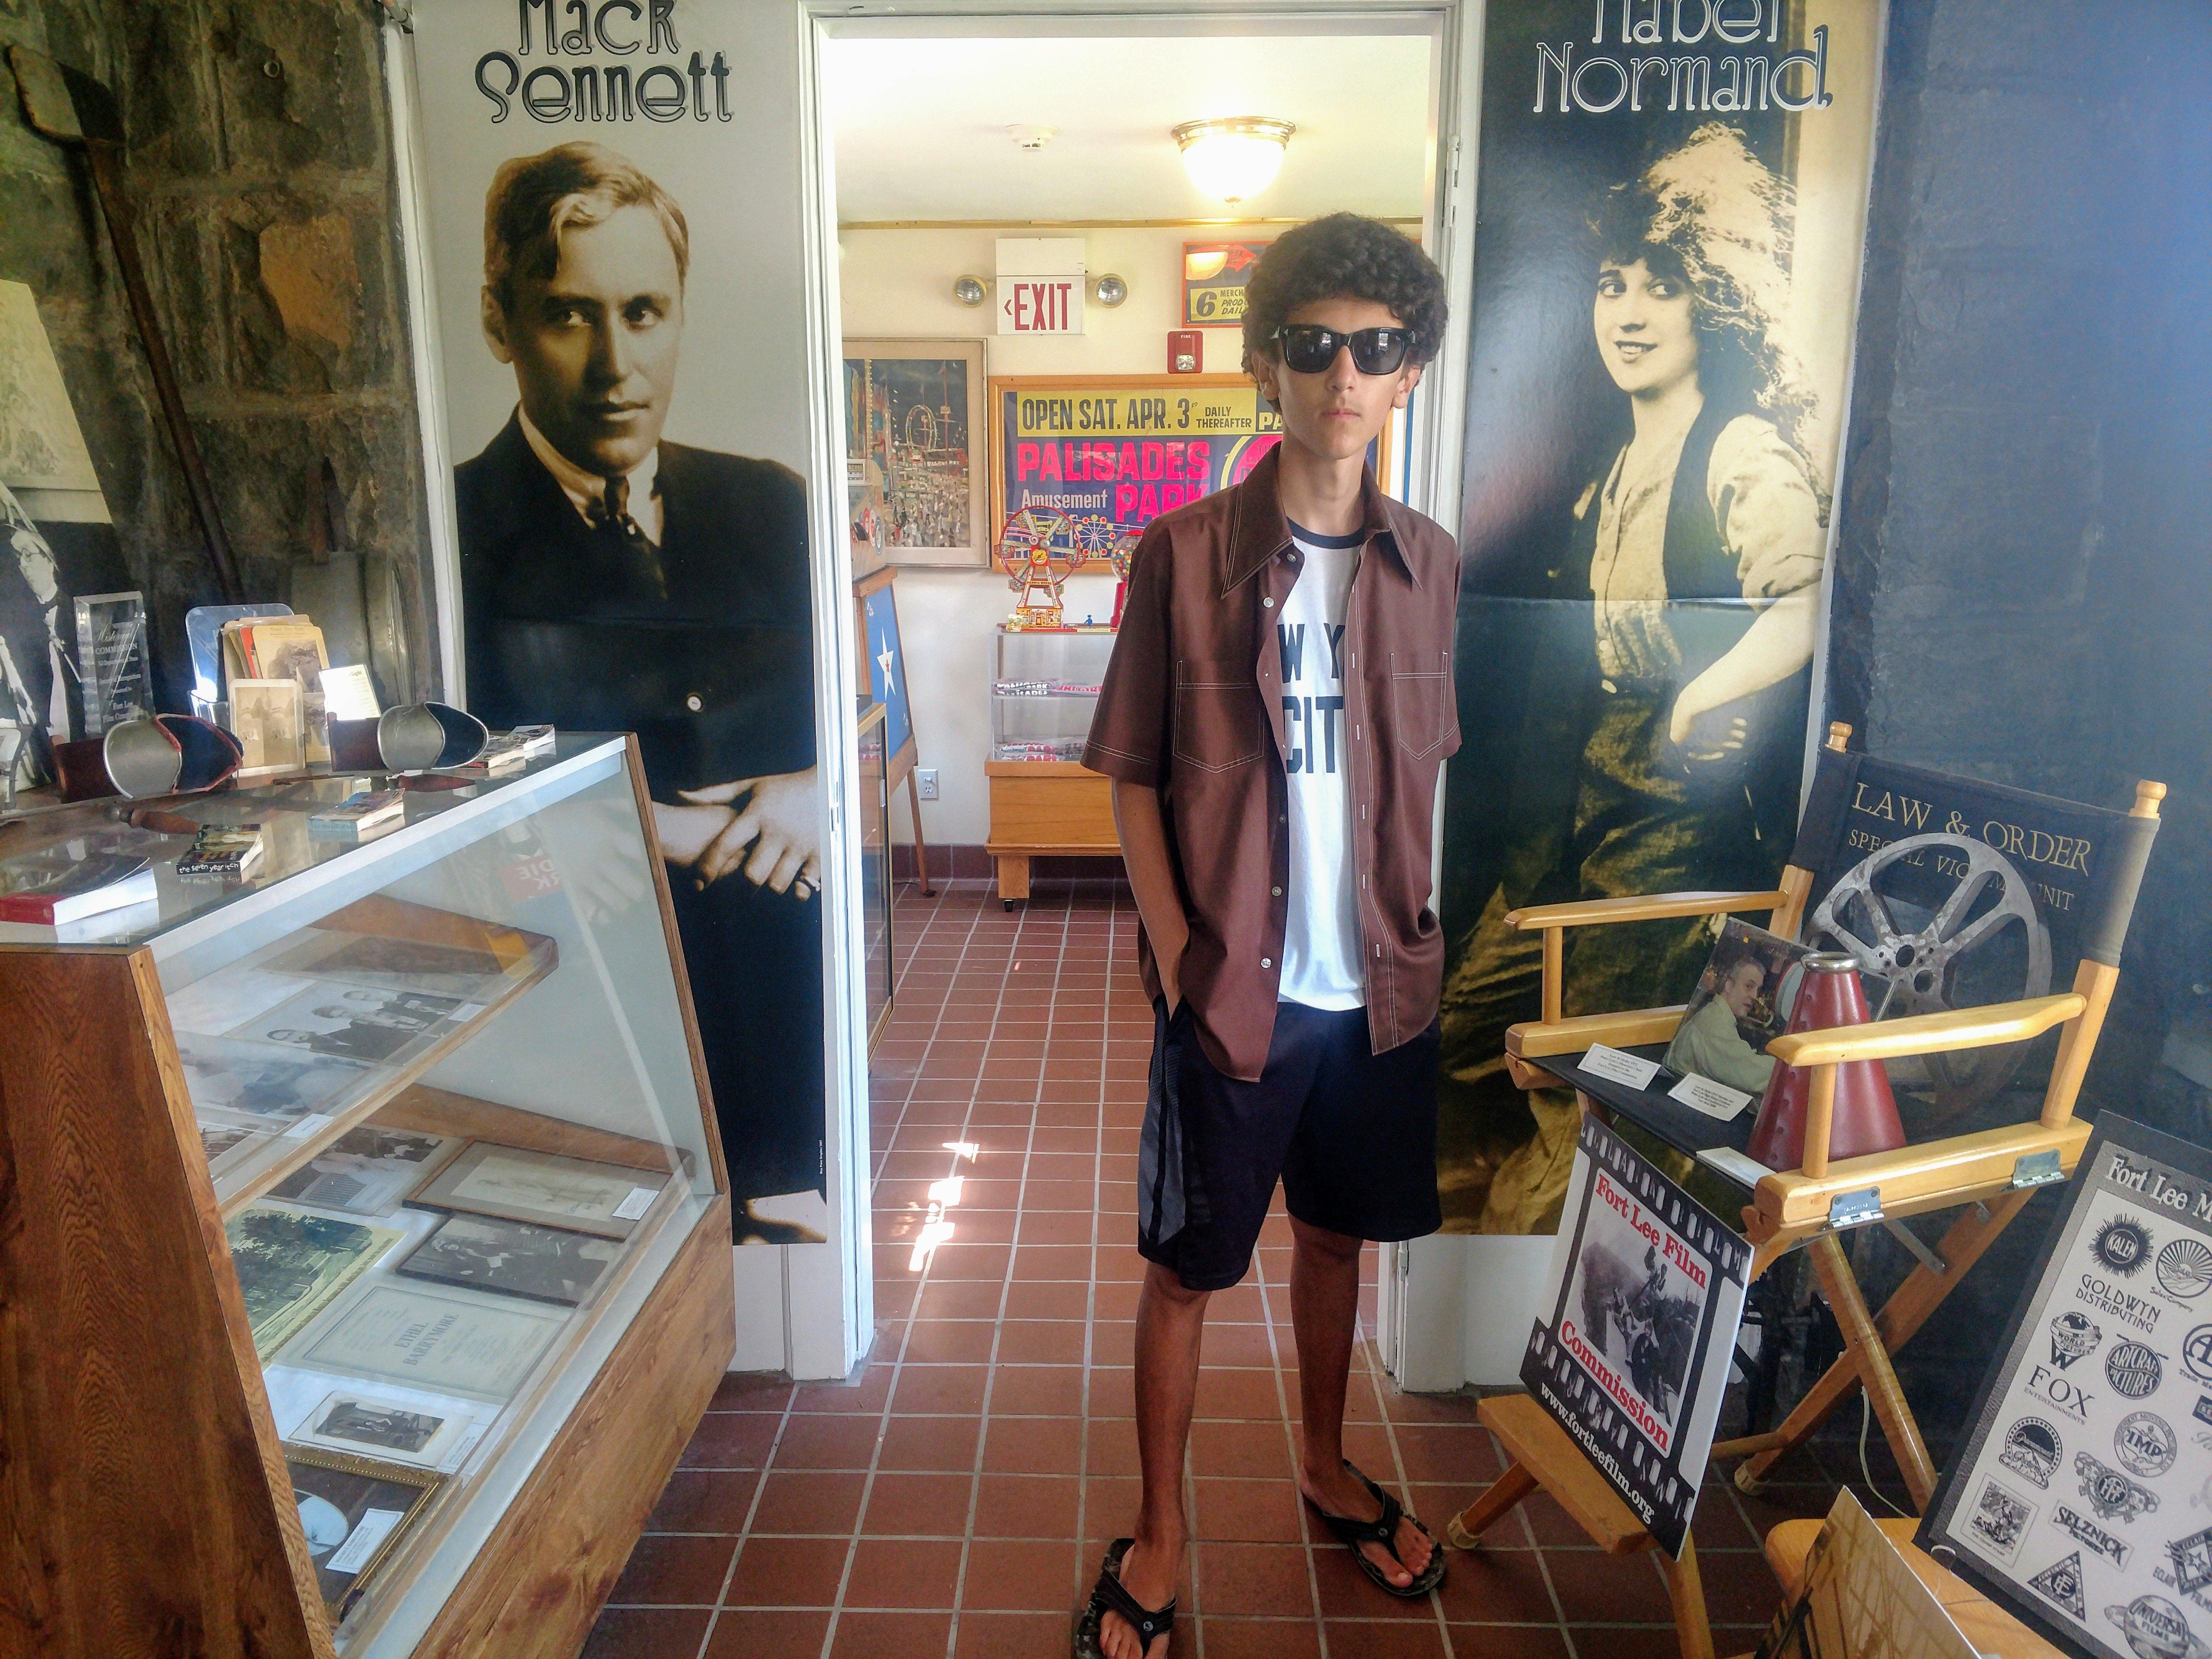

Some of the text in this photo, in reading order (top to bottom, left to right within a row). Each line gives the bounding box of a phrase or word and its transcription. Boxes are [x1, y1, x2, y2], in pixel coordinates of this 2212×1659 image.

[475, 51, 733, 124] Sennett
[1533, 31, 1830, 113] Normand
[1014, 283, 1071, 330] EXIT
[1196, 291, 1217, 317] 6
[1022, 399, 1072, 430] OPEN
[1080, 399, 1120, 430] SAT.
[1127, 398, 1171, 429] APR.
[1196, 417, 1253, 429] THEREAFTER
[1205, 406, 1232, 417] DAILY
[1017, 442, 1210, 481] PALISADES
[1021, 488, 1108, 510] Amusement
[1852, 782, 2092, 876] LAW & ORDER
[2105, 1156, 2148, 1193] Fort
[2150, 1175, 2188, 1211] Lee
[1595, 1173, 1706, 1290] Fort Lee Film
[2075, 1287, 2154, 1334] DISTRIBUTING
[2081, 1274, 2162, 1322] GOLDWYN
[403, 1313, 459, 1366] BARRYMORE
[1561, 1320, 1669, 1452] Commission
[2028, 1364, 2094, 1418] FOX
[2110, 1368, 2154, 1395] PICTURES
[2024, 1387, 2086, 1425] ENTERTAINMENTS
[1541, 1382, 1655, 1525] www.fortleefilm.org
[2126, 1431, 2162, 1457] IMP
[2053, 1506, 2128, 1567] SELZNICK
[2128, 1601, 2187, 1642] UNIVERSAL
